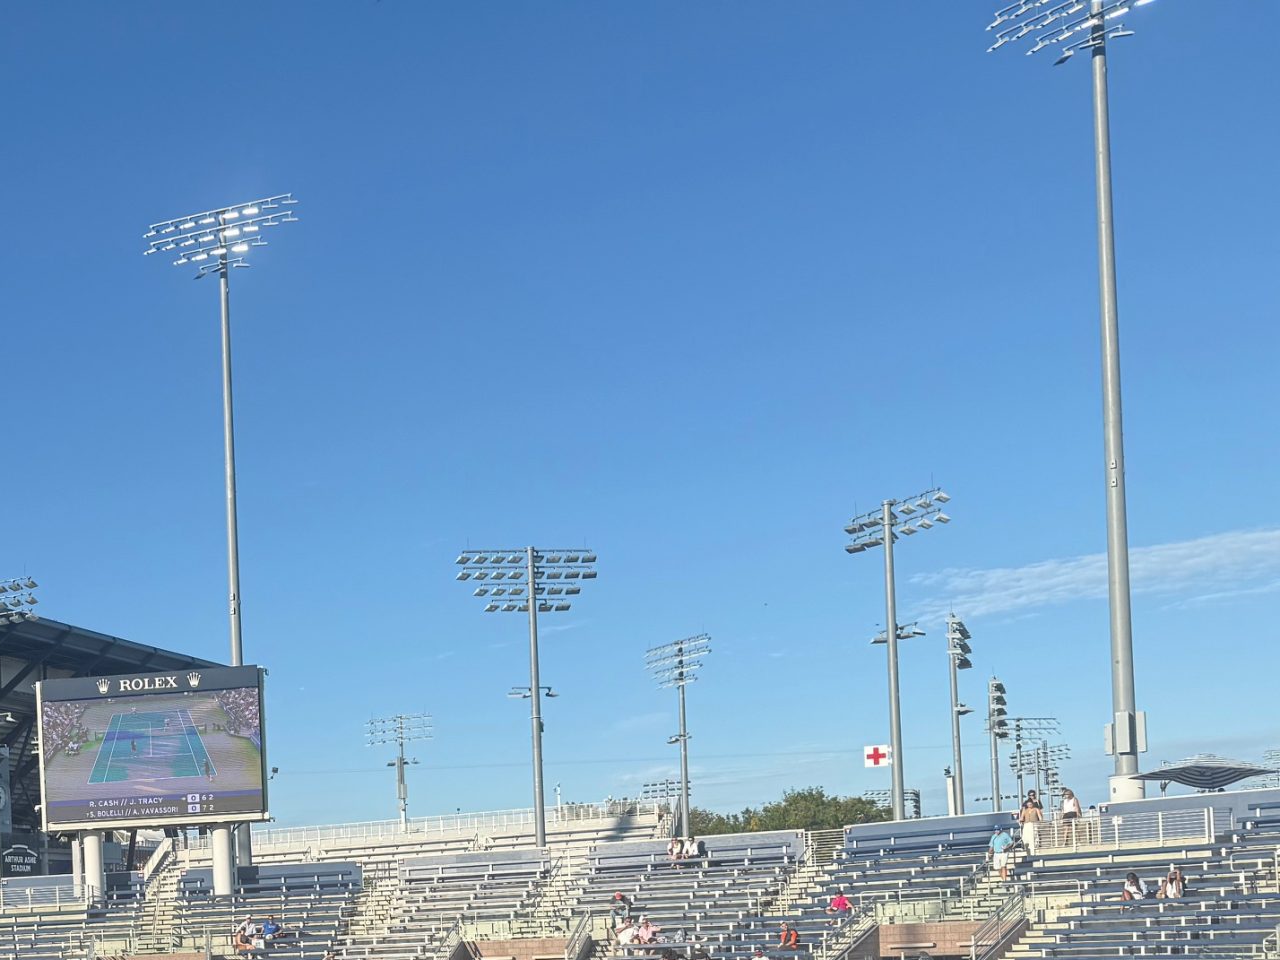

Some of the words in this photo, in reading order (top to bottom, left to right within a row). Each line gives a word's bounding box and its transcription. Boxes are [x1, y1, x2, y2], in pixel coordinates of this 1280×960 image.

[119, 676, 178, 691] ROLEX
[98, 799, 119, 807] CASH
[138, 797, 163, 805] TRACY
[97, 809, 124, 818] BOLELLI
[141, 806, 178, 815] VAVASSORI
[24, 856, 36, 864] ASHE
[10, 864, 31, 872] STADIUM
